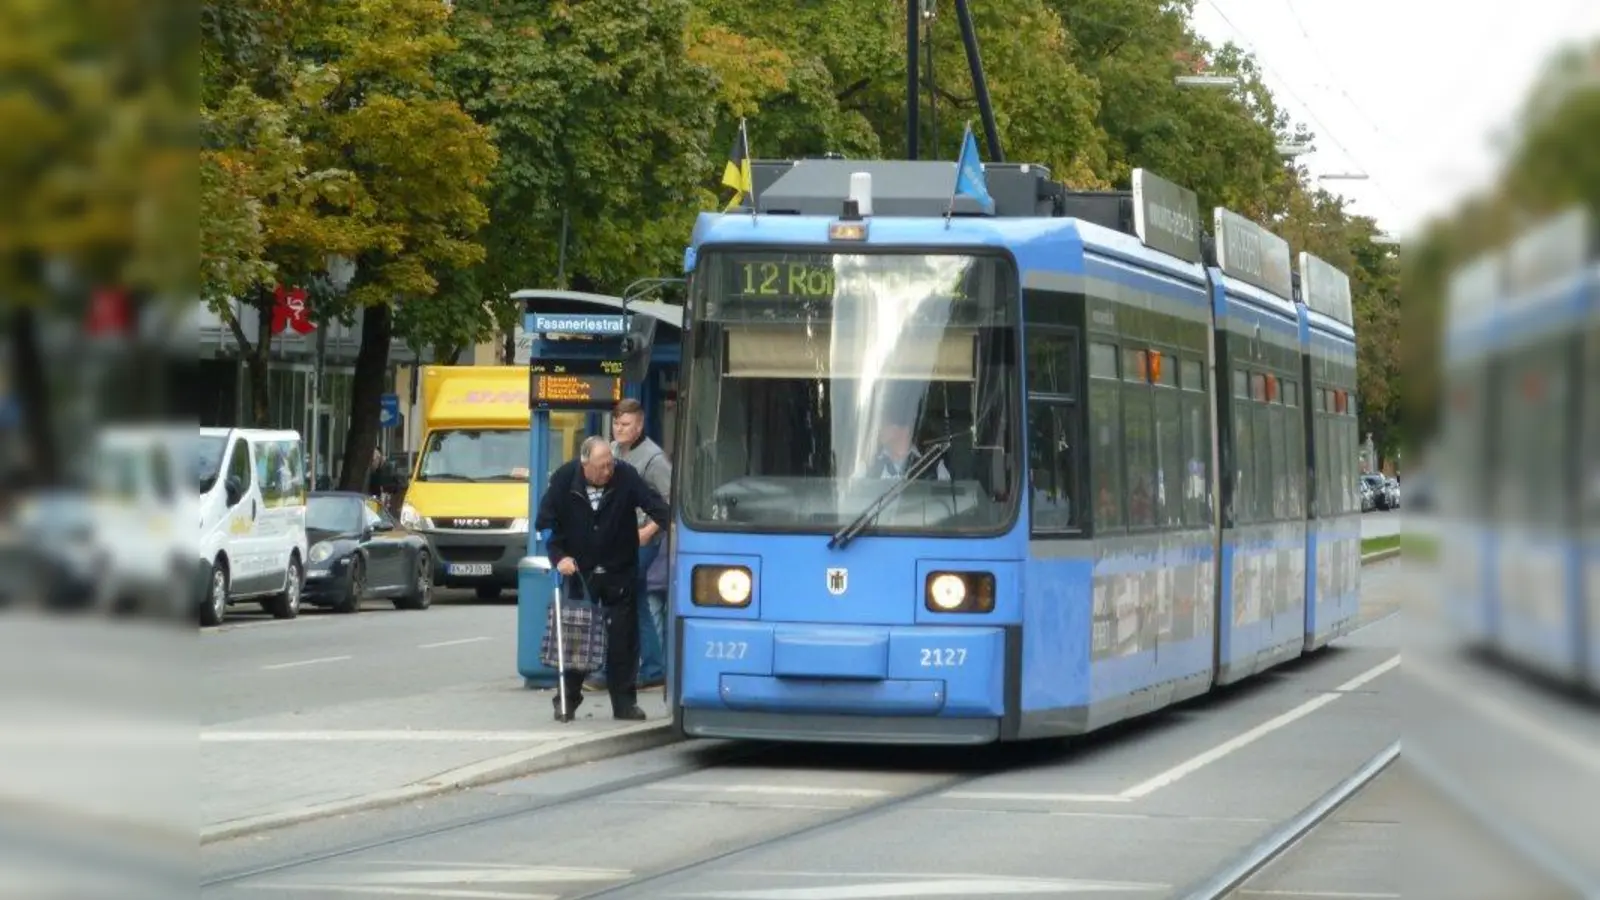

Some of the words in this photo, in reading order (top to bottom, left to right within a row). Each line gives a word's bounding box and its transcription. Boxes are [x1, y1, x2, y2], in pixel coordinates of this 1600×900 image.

[743, 262, 780, 294] 12
[453, 518, 490, 527] IVECO
[704, 640, 748, 661] 2127
[919, 646, 969, 668] 2127
